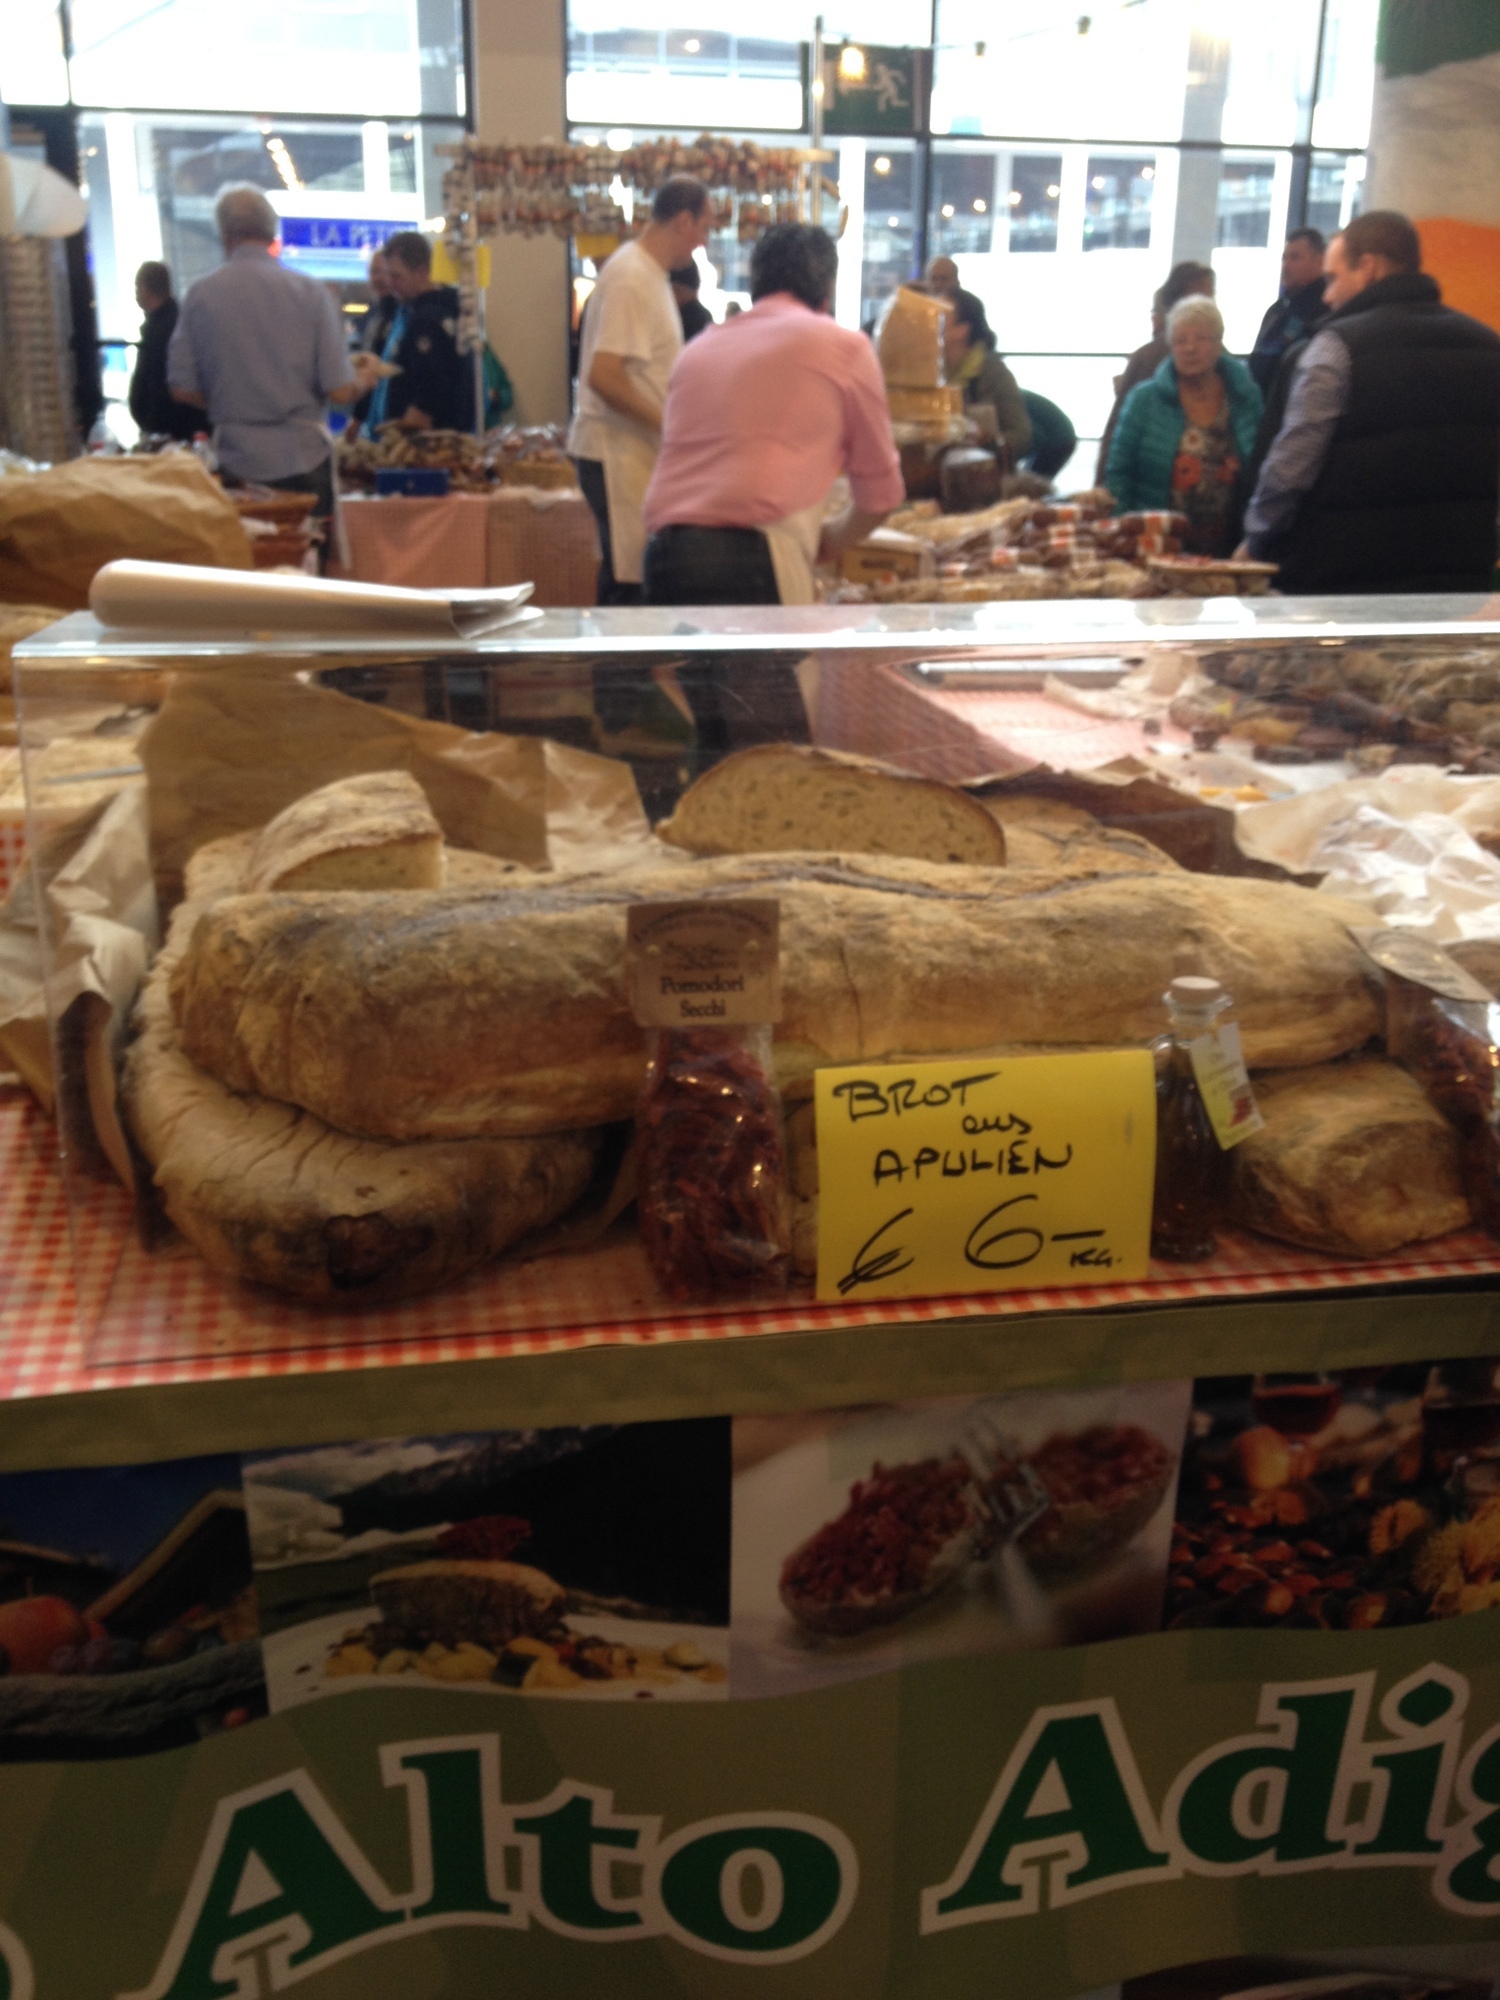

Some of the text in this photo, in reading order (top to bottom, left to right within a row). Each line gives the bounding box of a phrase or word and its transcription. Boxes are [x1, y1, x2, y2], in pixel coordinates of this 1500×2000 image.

[660, 976, 745, 995] Pomodori
[680, 999, 727, 1017] Secchi
[832, 1071, 1002, 1123] BROT
[962, 1113, 1032, 1136] aus
[874, 1140, 1072, 1187] APULIEN
[113, 1733, 859, 2000] Alto
